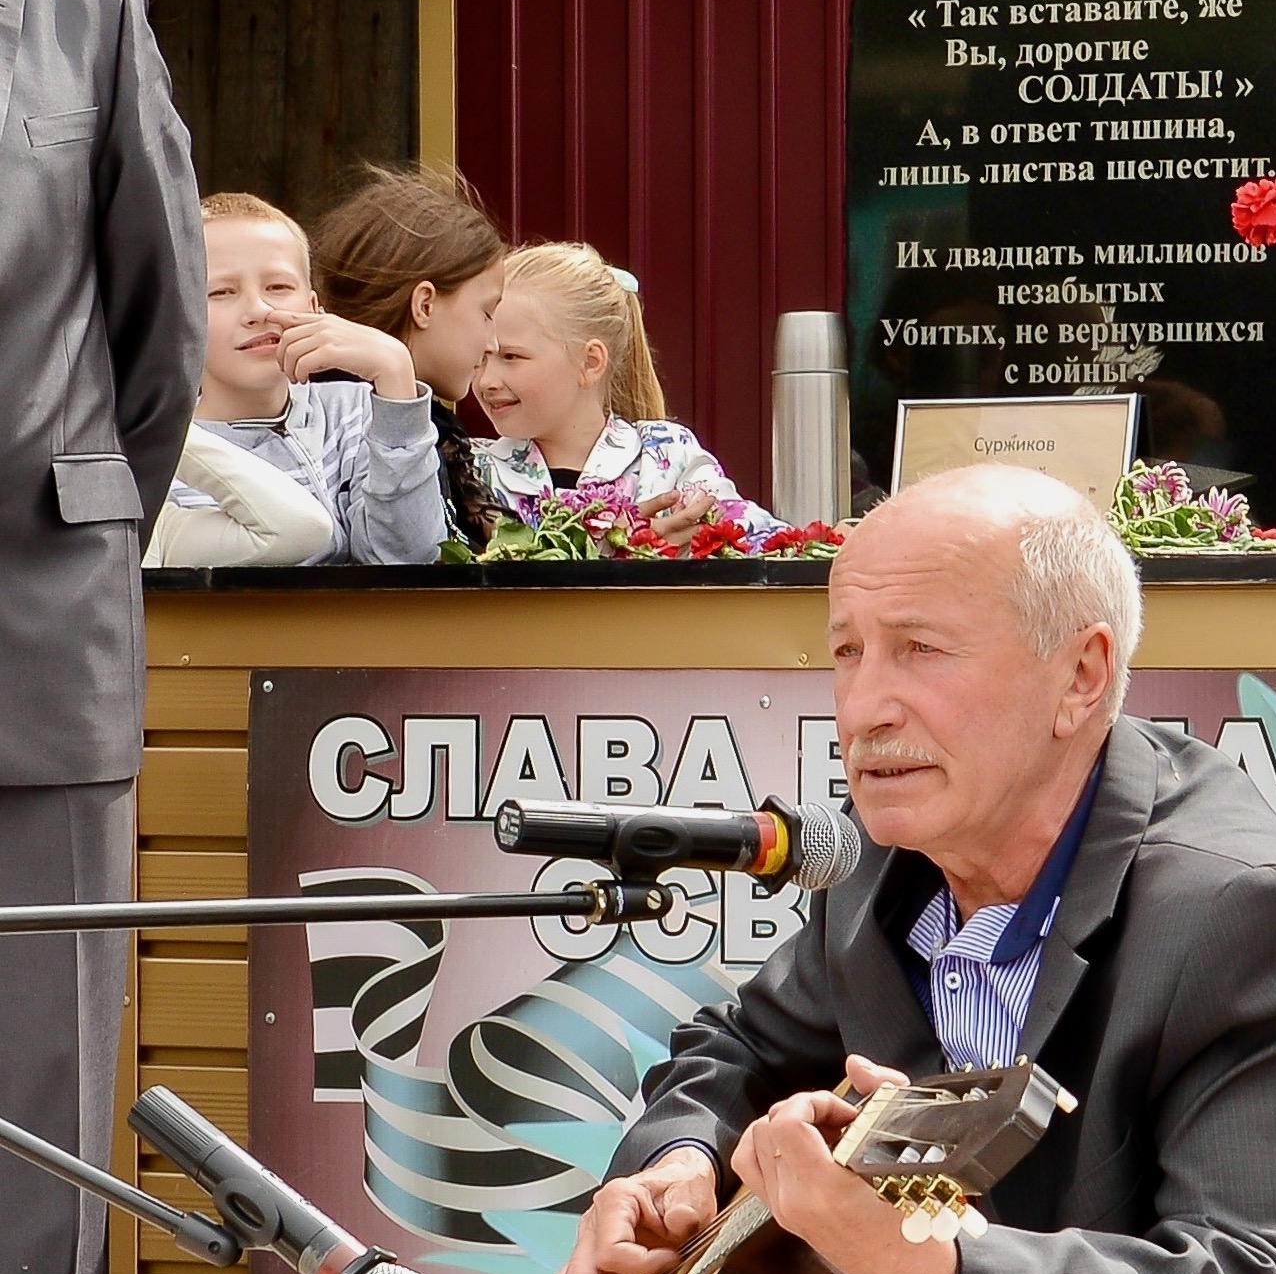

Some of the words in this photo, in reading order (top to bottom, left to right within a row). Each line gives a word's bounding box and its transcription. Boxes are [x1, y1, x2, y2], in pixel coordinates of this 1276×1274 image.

[936, 0, 1000, 28] Так
[945, 39, 1006, 70] Вы,
[1015, 38, 1149, 72] дорогие
[1018, 69, 1224, 107] СОЛДАТЫ!
[916, 119, 951, 148] А,
[962, 121, 980, 145] в
[990, 118, 1081, 145] ответ
[1090, 112, 1236, 143] тишина,
[878, 163, 971, 187] лишь
[980, 159, 1095, 185] листва
[1106, 156, 1276, 181] шелестит.
[896, 242, 937, 270] Их
[945, 242, 1084, 272] двадцать
[1094, 242, 1268, 266] миллионов
[997, 278, 1165, 306] незабытых
[881, 319, 1006, 351] Убитых,
[1016, 321, 1049, 345] не
[1058, 317, 1265, 351] вернувшихся
[1005, 362, 1019, 385] с
[974, 437, 1056, 455] Суржиков
[307, 714, 766, 823] СЛАВА
